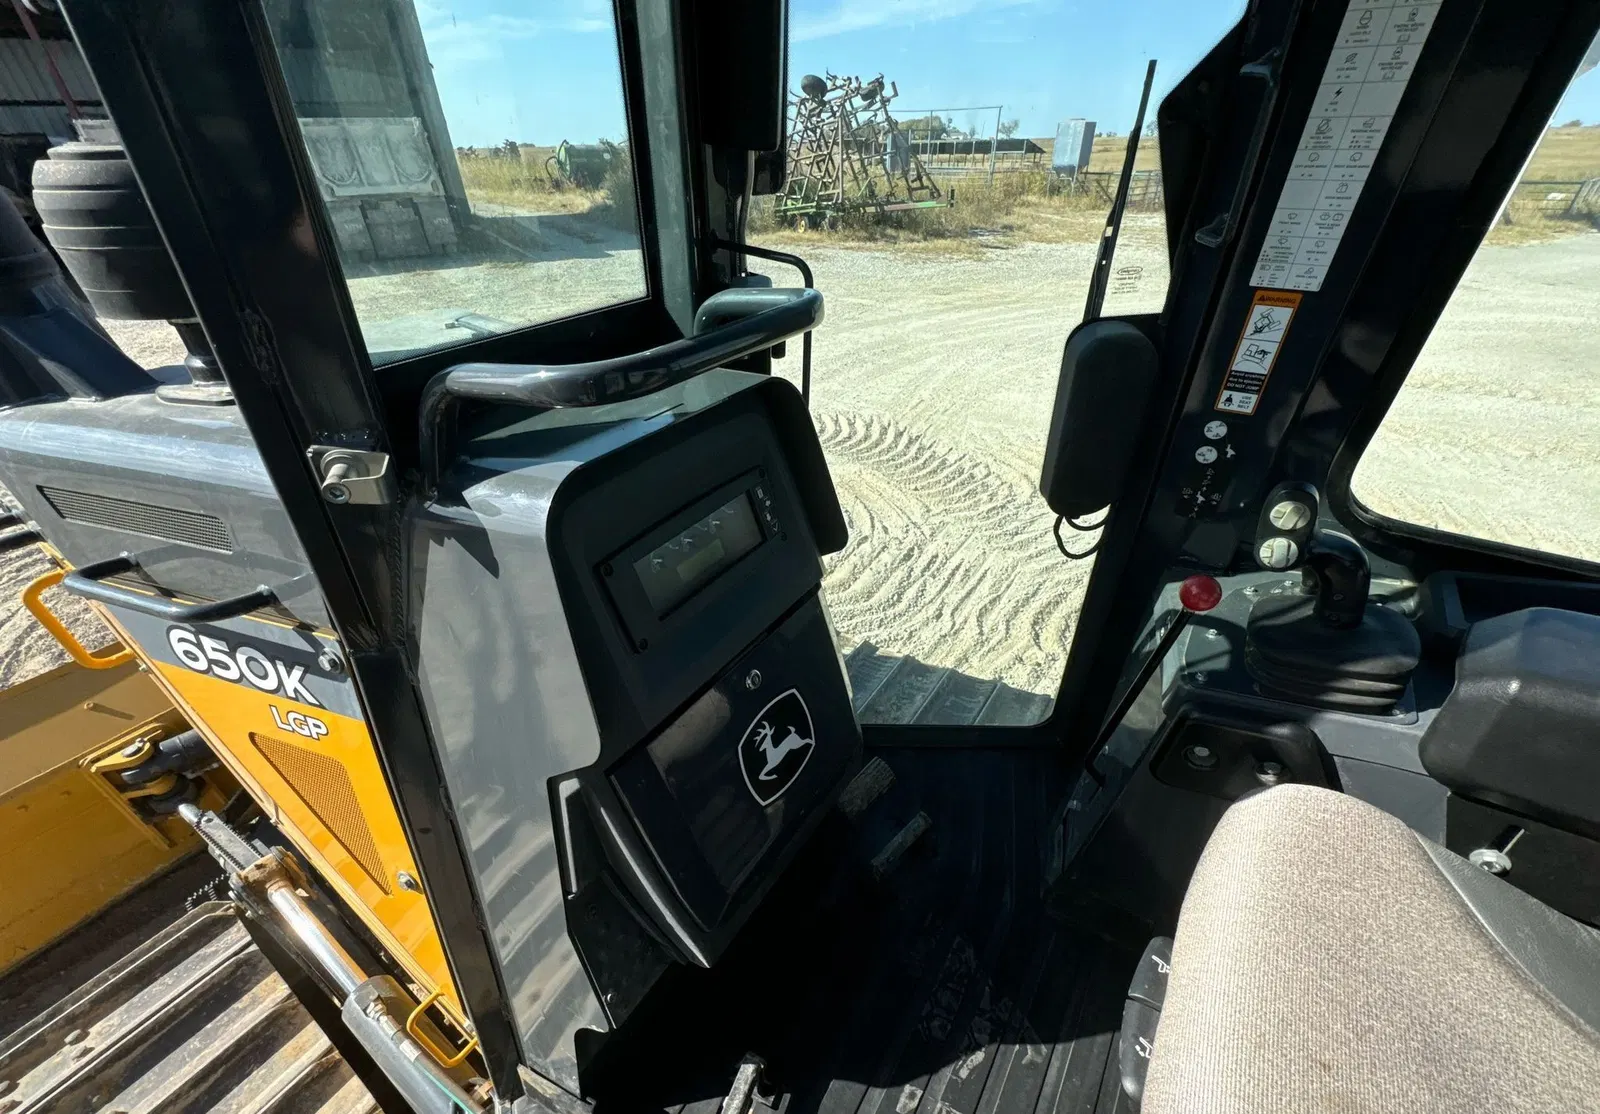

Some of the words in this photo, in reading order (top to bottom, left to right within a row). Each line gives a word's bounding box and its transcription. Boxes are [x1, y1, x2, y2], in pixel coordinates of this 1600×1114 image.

[1265, 295, 1297, 305] WARNING
[167, 626, 322, 707] 650K
[269, 704, 329, 741] LGP
